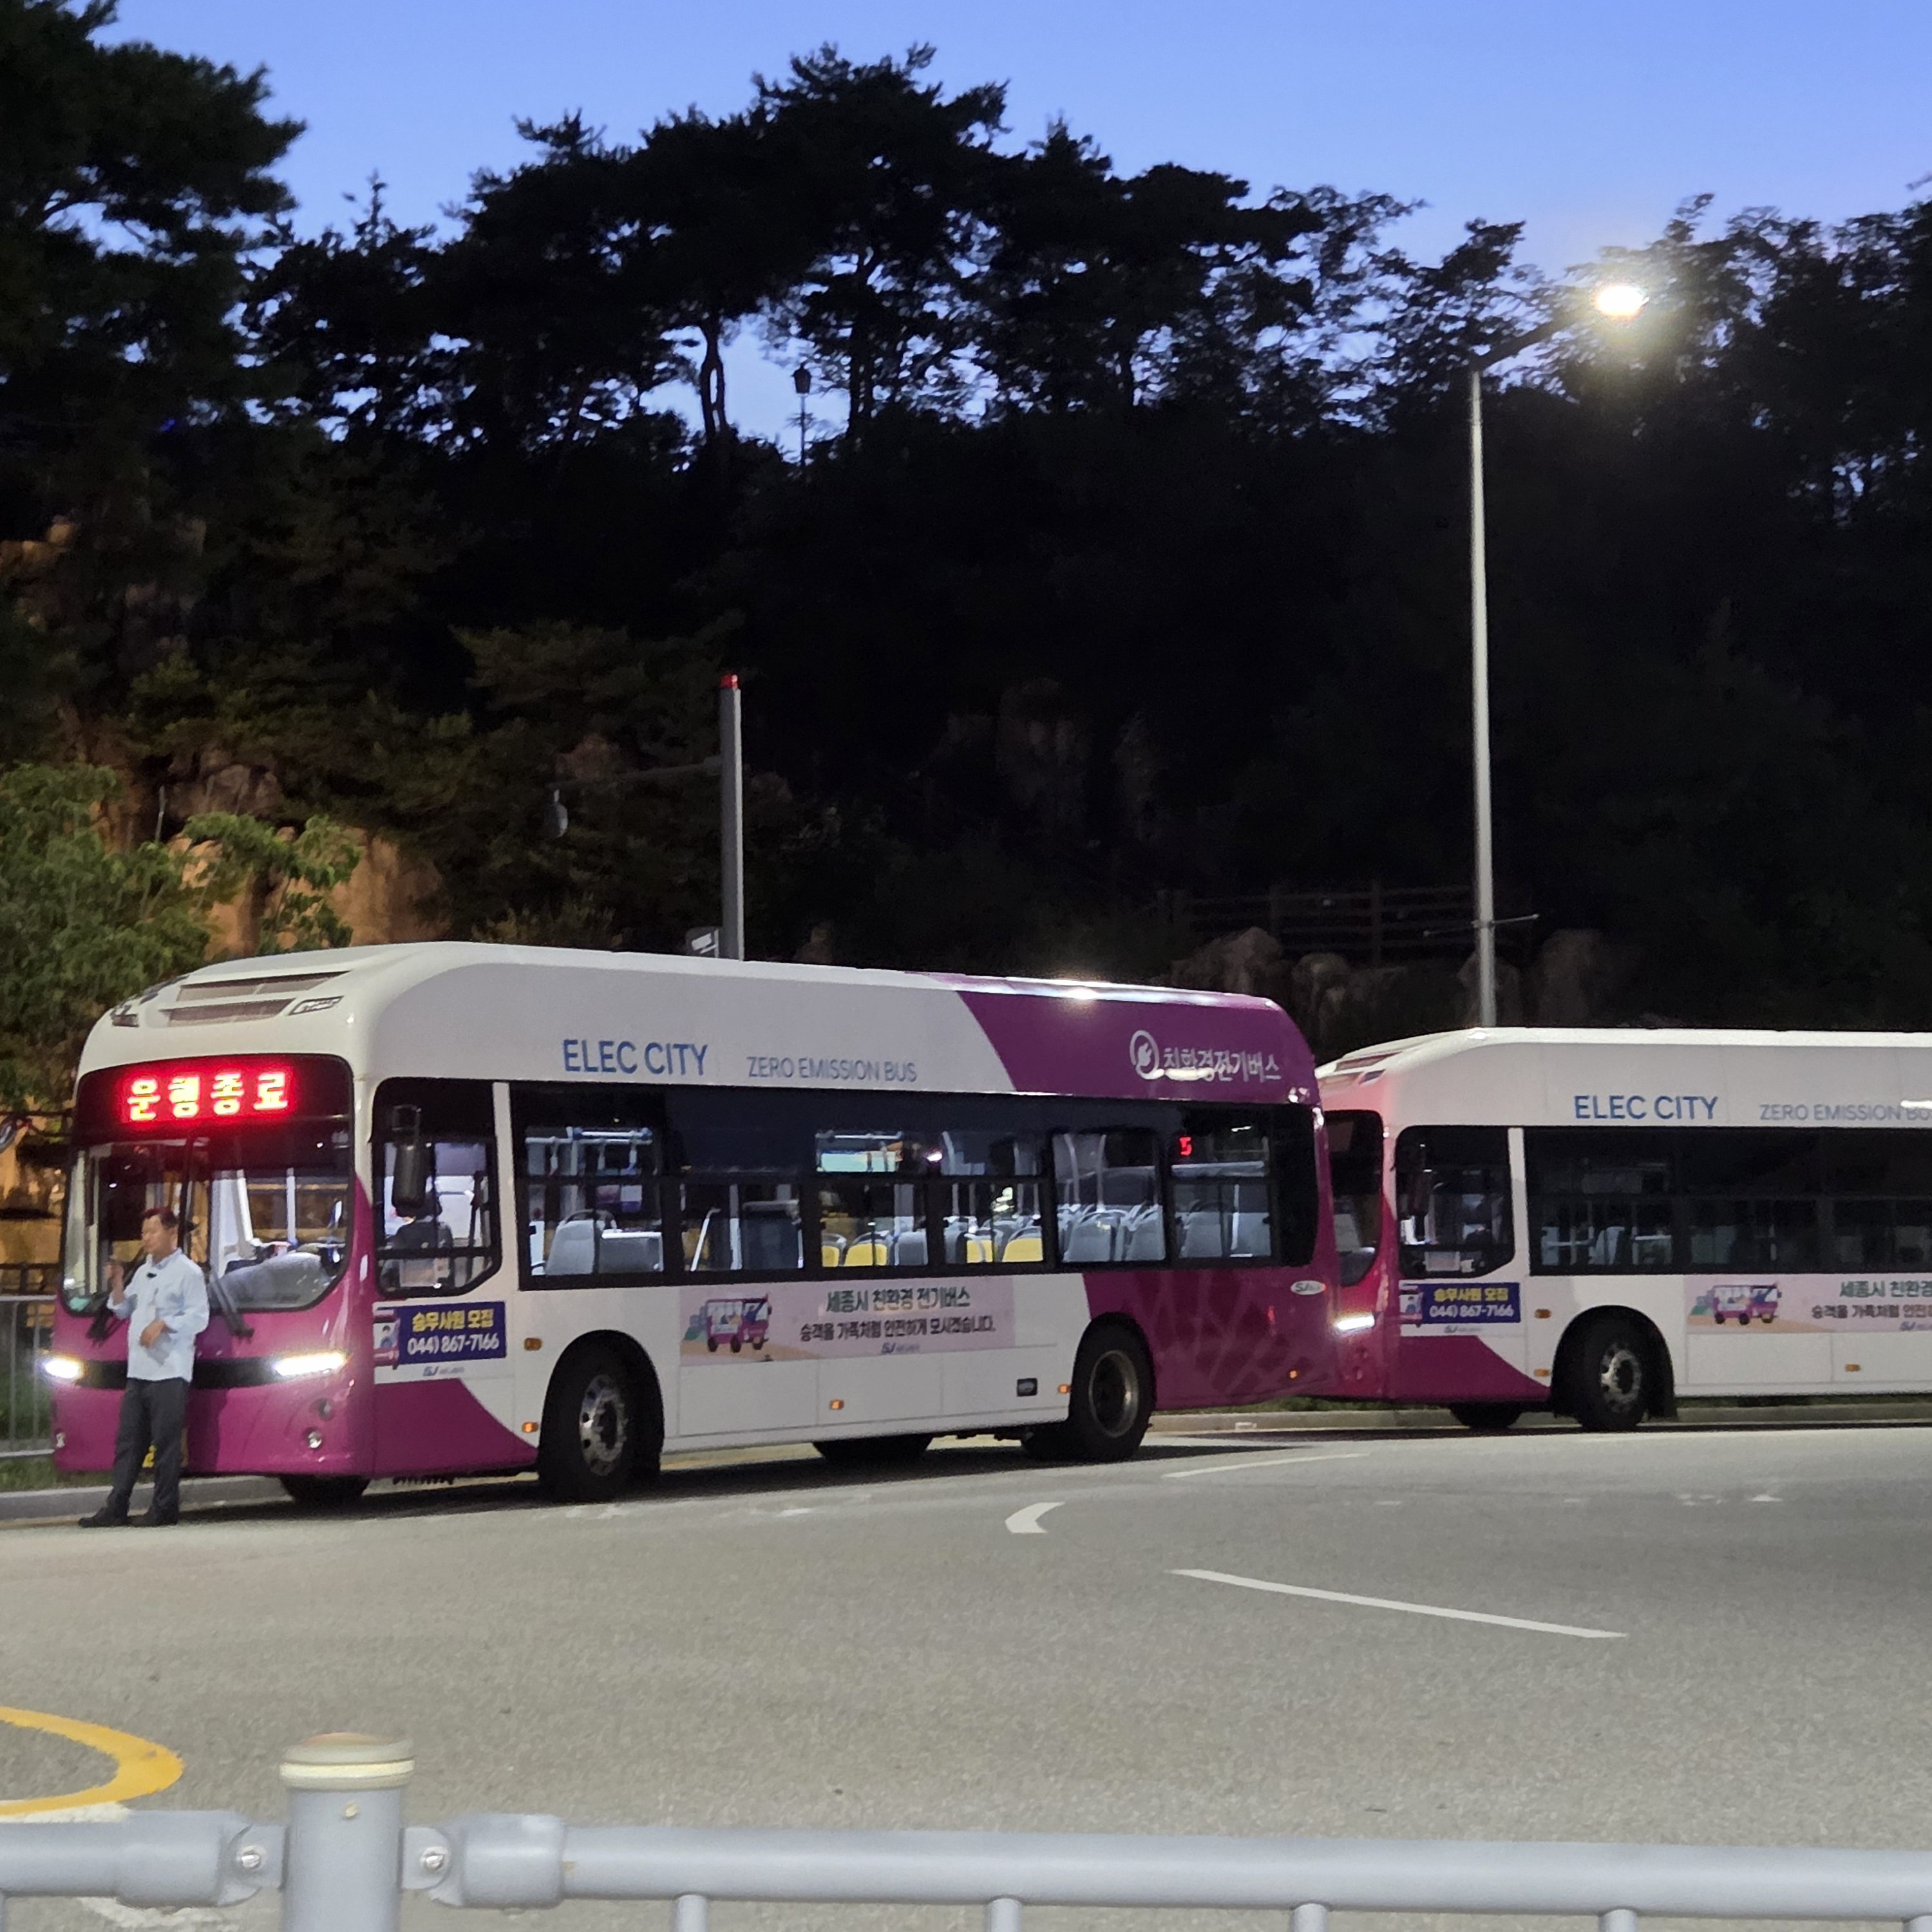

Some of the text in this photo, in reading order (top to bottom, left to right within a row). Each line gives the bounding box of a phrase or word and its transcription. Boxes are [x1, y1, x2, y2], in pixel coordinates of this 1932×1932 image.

[563, 1039, 708, 1076] ELEC CITY
[747, 1056, 917, 1083] ZERO EMISSION BUS
[128, 1072, 289, 1121] 운행종료
[1575, 1095, 1718, 1121] ELEC CITY
[1759, 1104, 1932, 1121] ZERO EMISSION BU
[826, 1286, 971, 1312] 세종시 친환경 전기버스
[412, 1308, 495, 1332] 승무사원 모집
[800, 1323, 834, 1341] 승객을
[837, 1320, 881, 1340] 가족처럼
[885, 1318, 927, 1337] 안전하게
